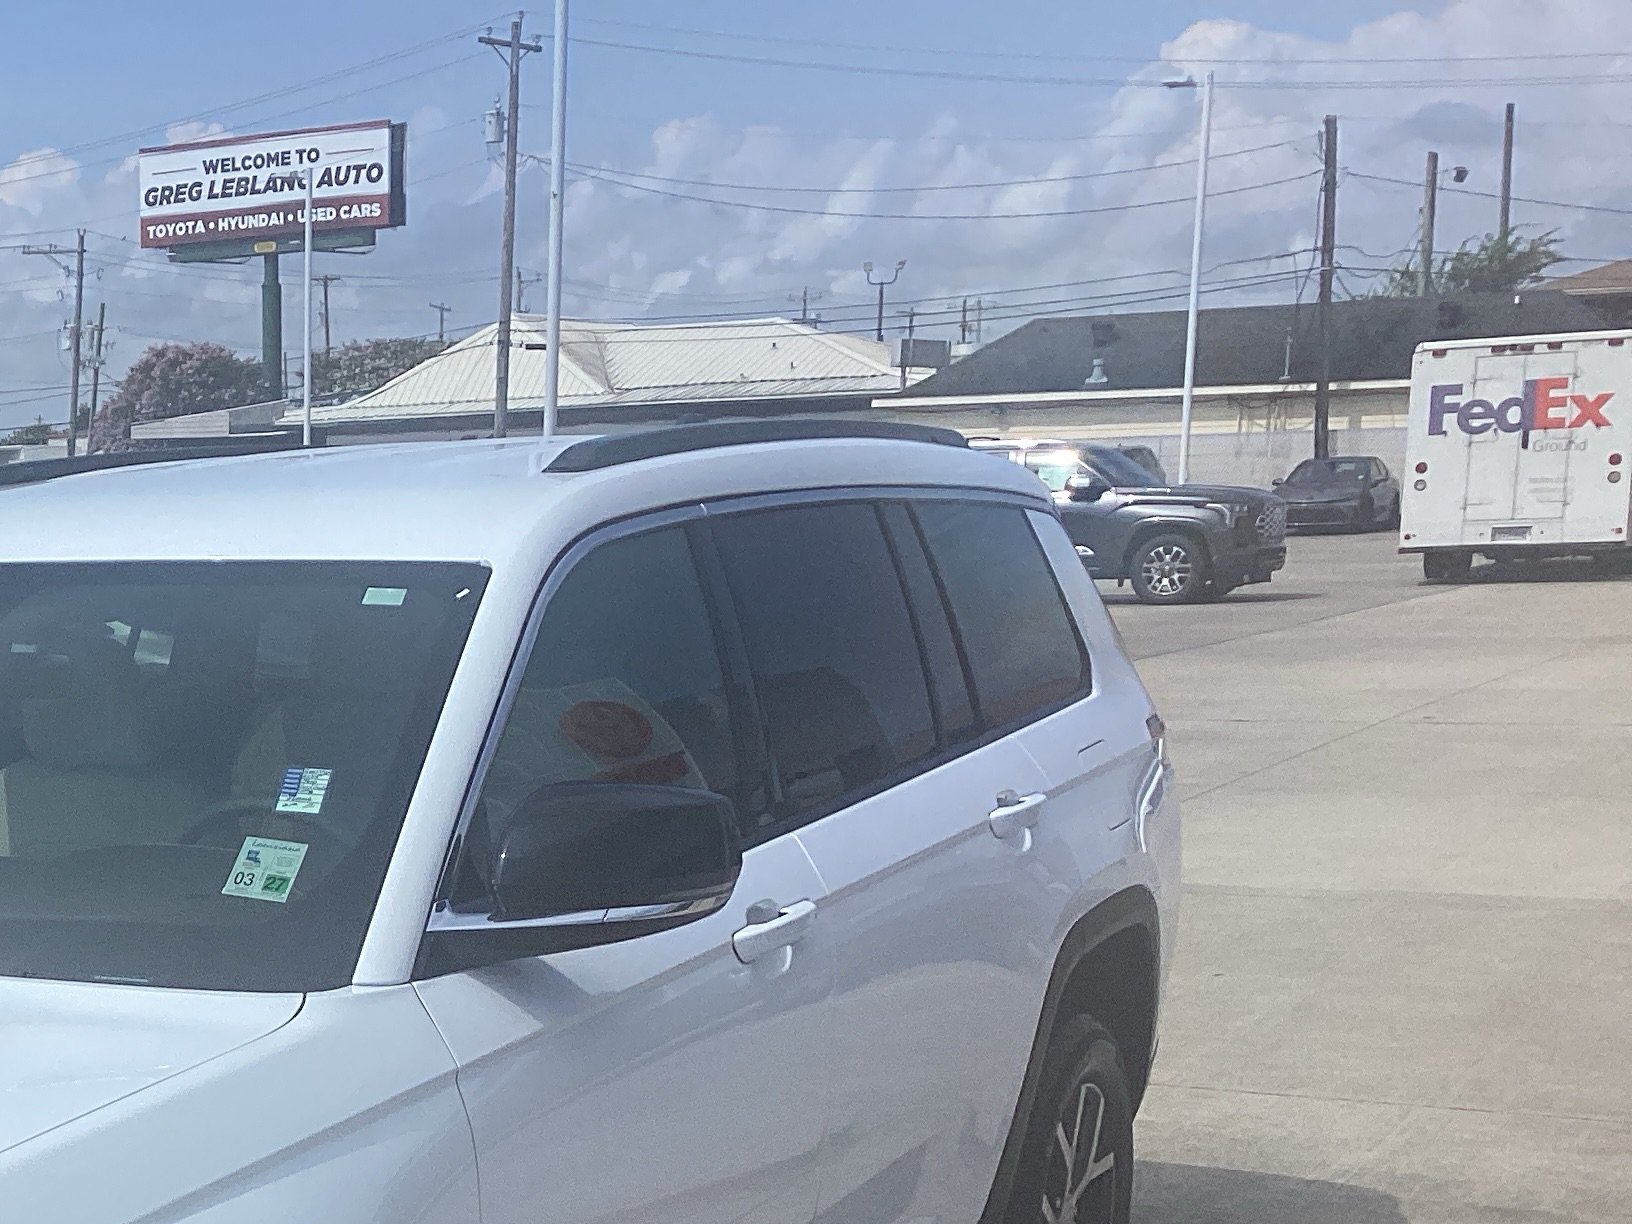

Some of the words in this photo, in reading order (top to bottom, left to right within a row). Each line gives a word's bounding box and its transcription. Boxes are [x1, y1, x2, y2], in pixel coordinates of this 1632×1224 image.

[202, 151, 291, 176] WELCOME
[295, 148, 320, 163] TO
[144, 181, 203, 206] GREG
[316, 162, 384, 189] AUTO
[147, 219, 206, 239] TOYOTA
[218, 211, 285, 232] HYUNDAI
[340, 203, 381, 219] CARS
[1428, 377, 1616, 437] FedEx
[1533, 438, 1587, 452] Ground
[233, 871, 255, 886] 03
[262, 876, 289, 891] 27
